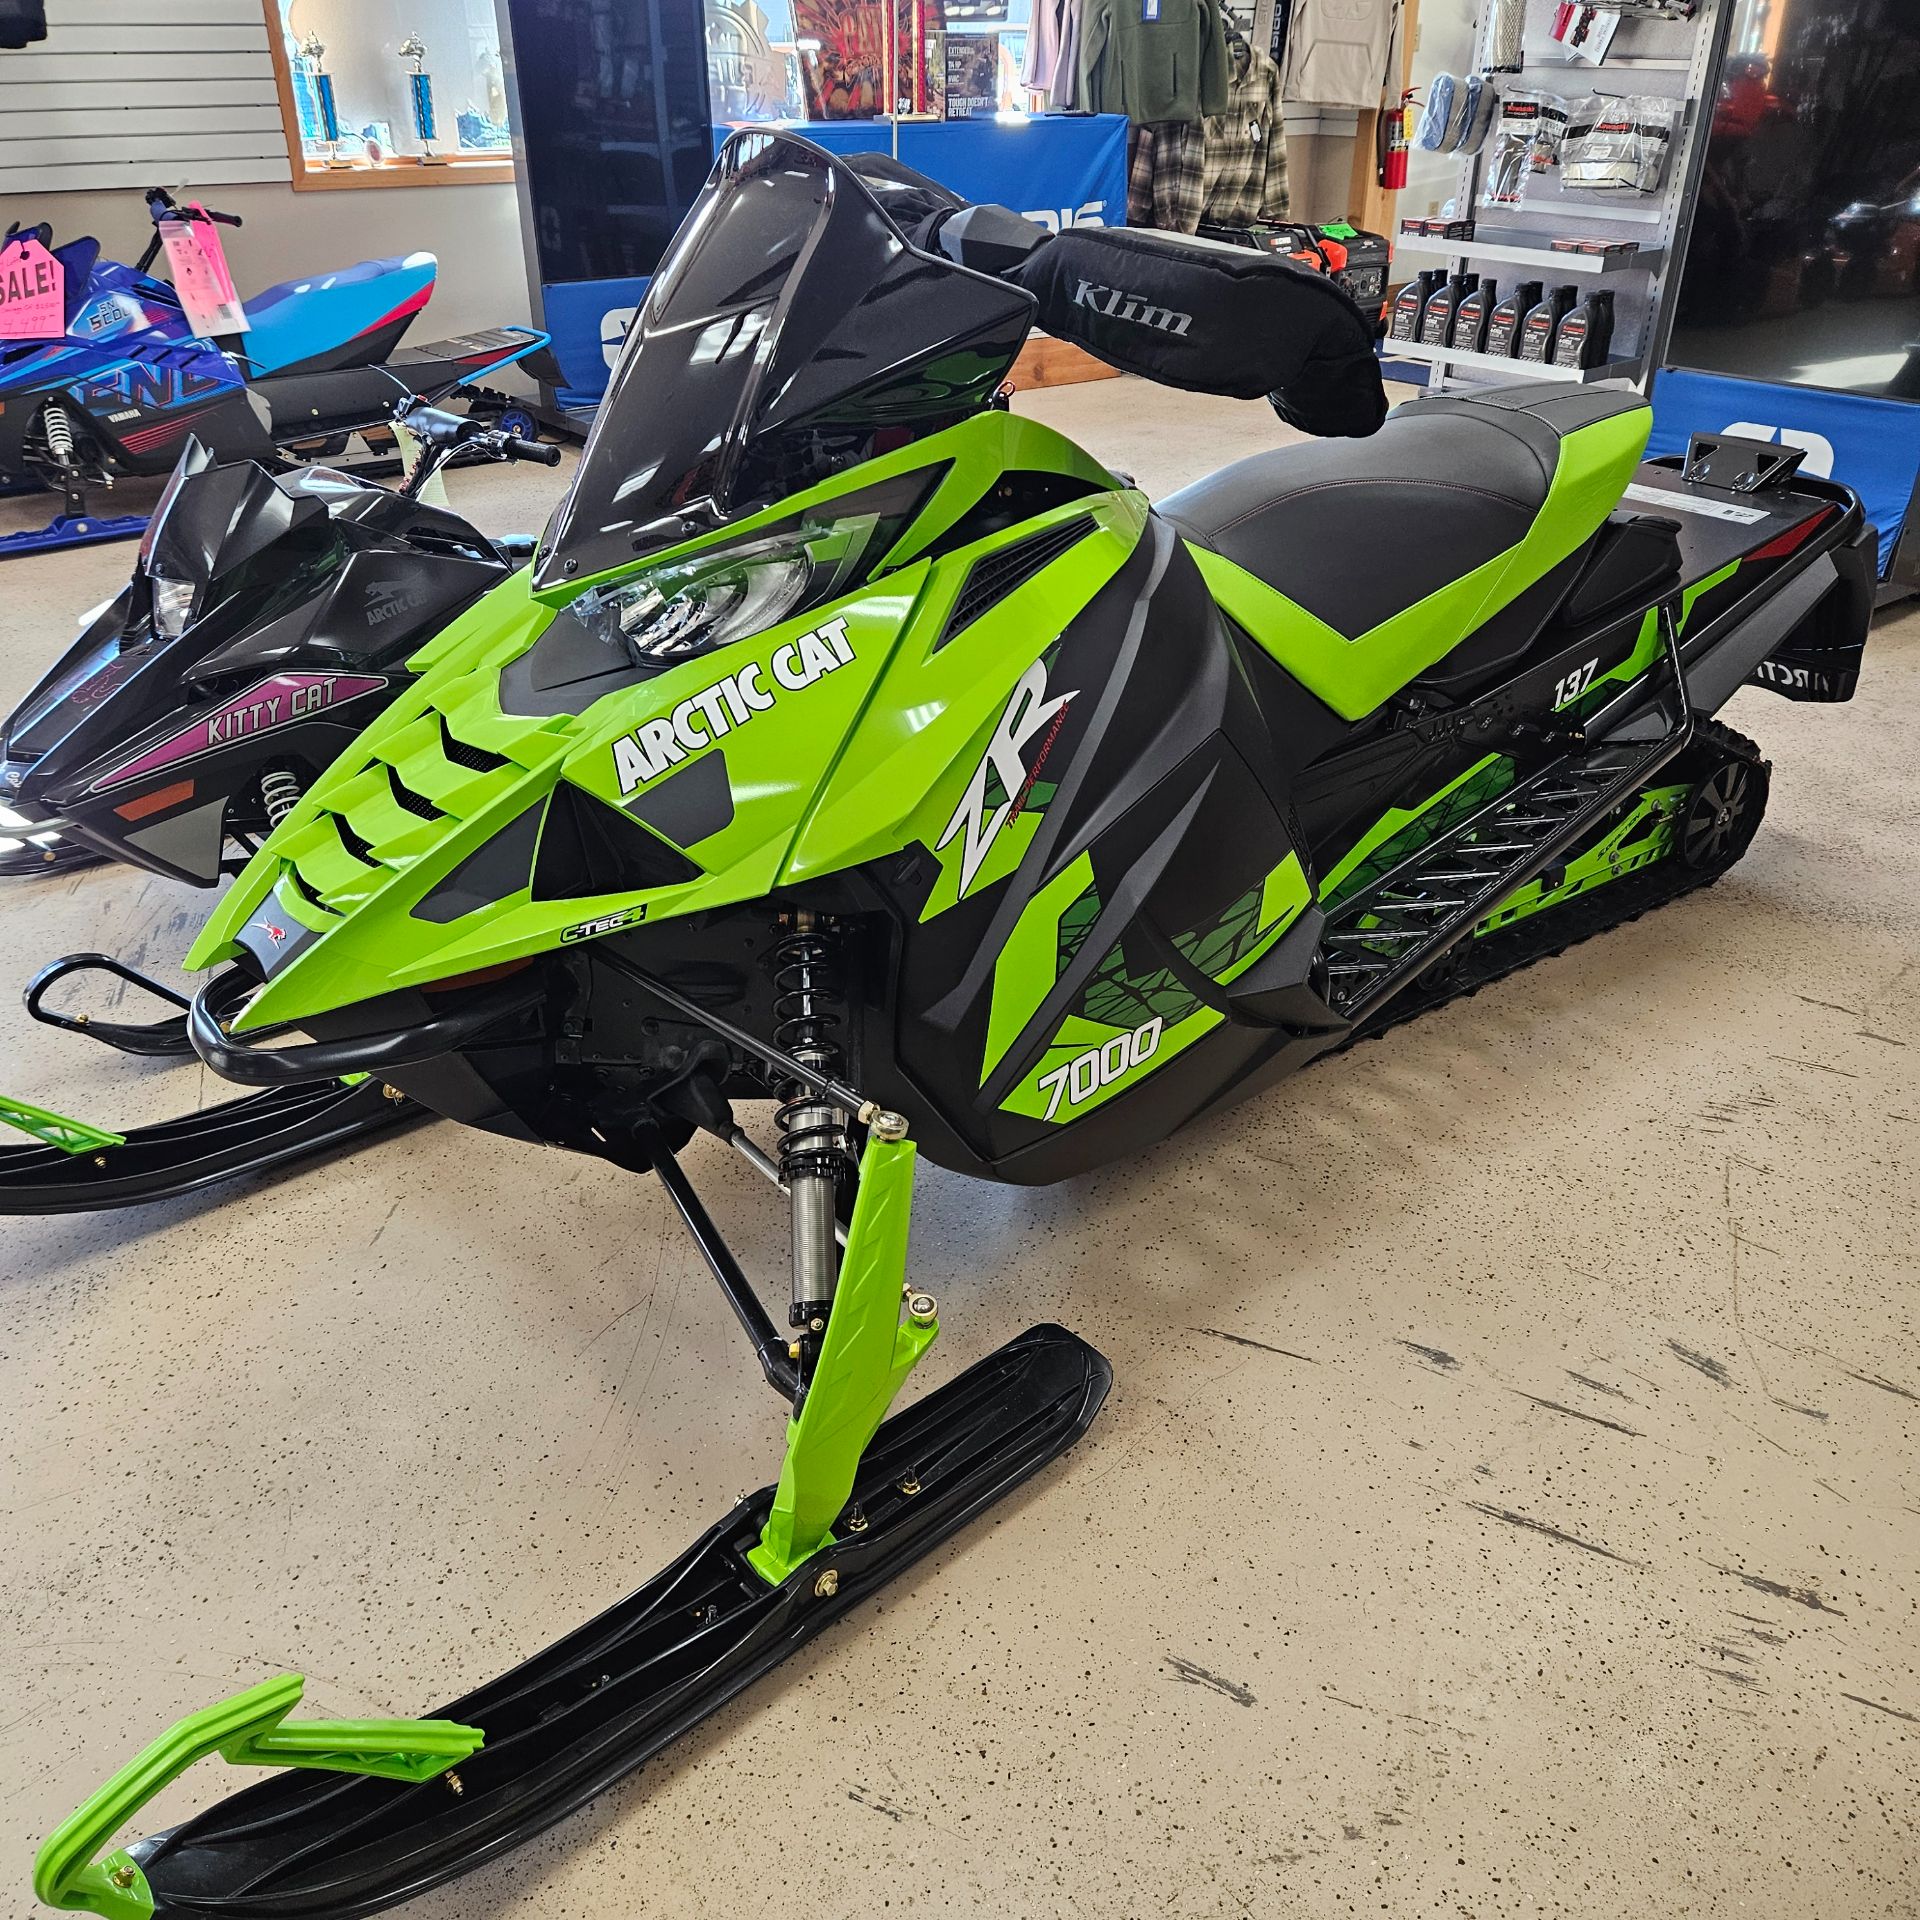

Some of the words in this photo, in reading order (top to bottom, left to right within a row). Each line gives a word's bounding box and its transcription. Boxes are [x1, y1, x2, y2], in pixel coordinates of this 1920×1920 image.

[108, 408, 142, 423] YAMAHA
[366, 597, 409, 626] ARCTIC
[207, 694, 283, 746] KITTY
[290, 677, 338, 717] CAT
[611, 661, 777, 797] ARCTIC
[770, 615, 857, 691] CAT
[1554, 657, 1599, 709] 137
[934, 656, 1081, 901] ZR
[1005, 793, 1027, 830] TRAIL
[1023, 699, 1071, 793] PERFORMANCE
[562, 906, 645, 941] C-TEC4
[1038, 1015, 1163, 1122] 7000
